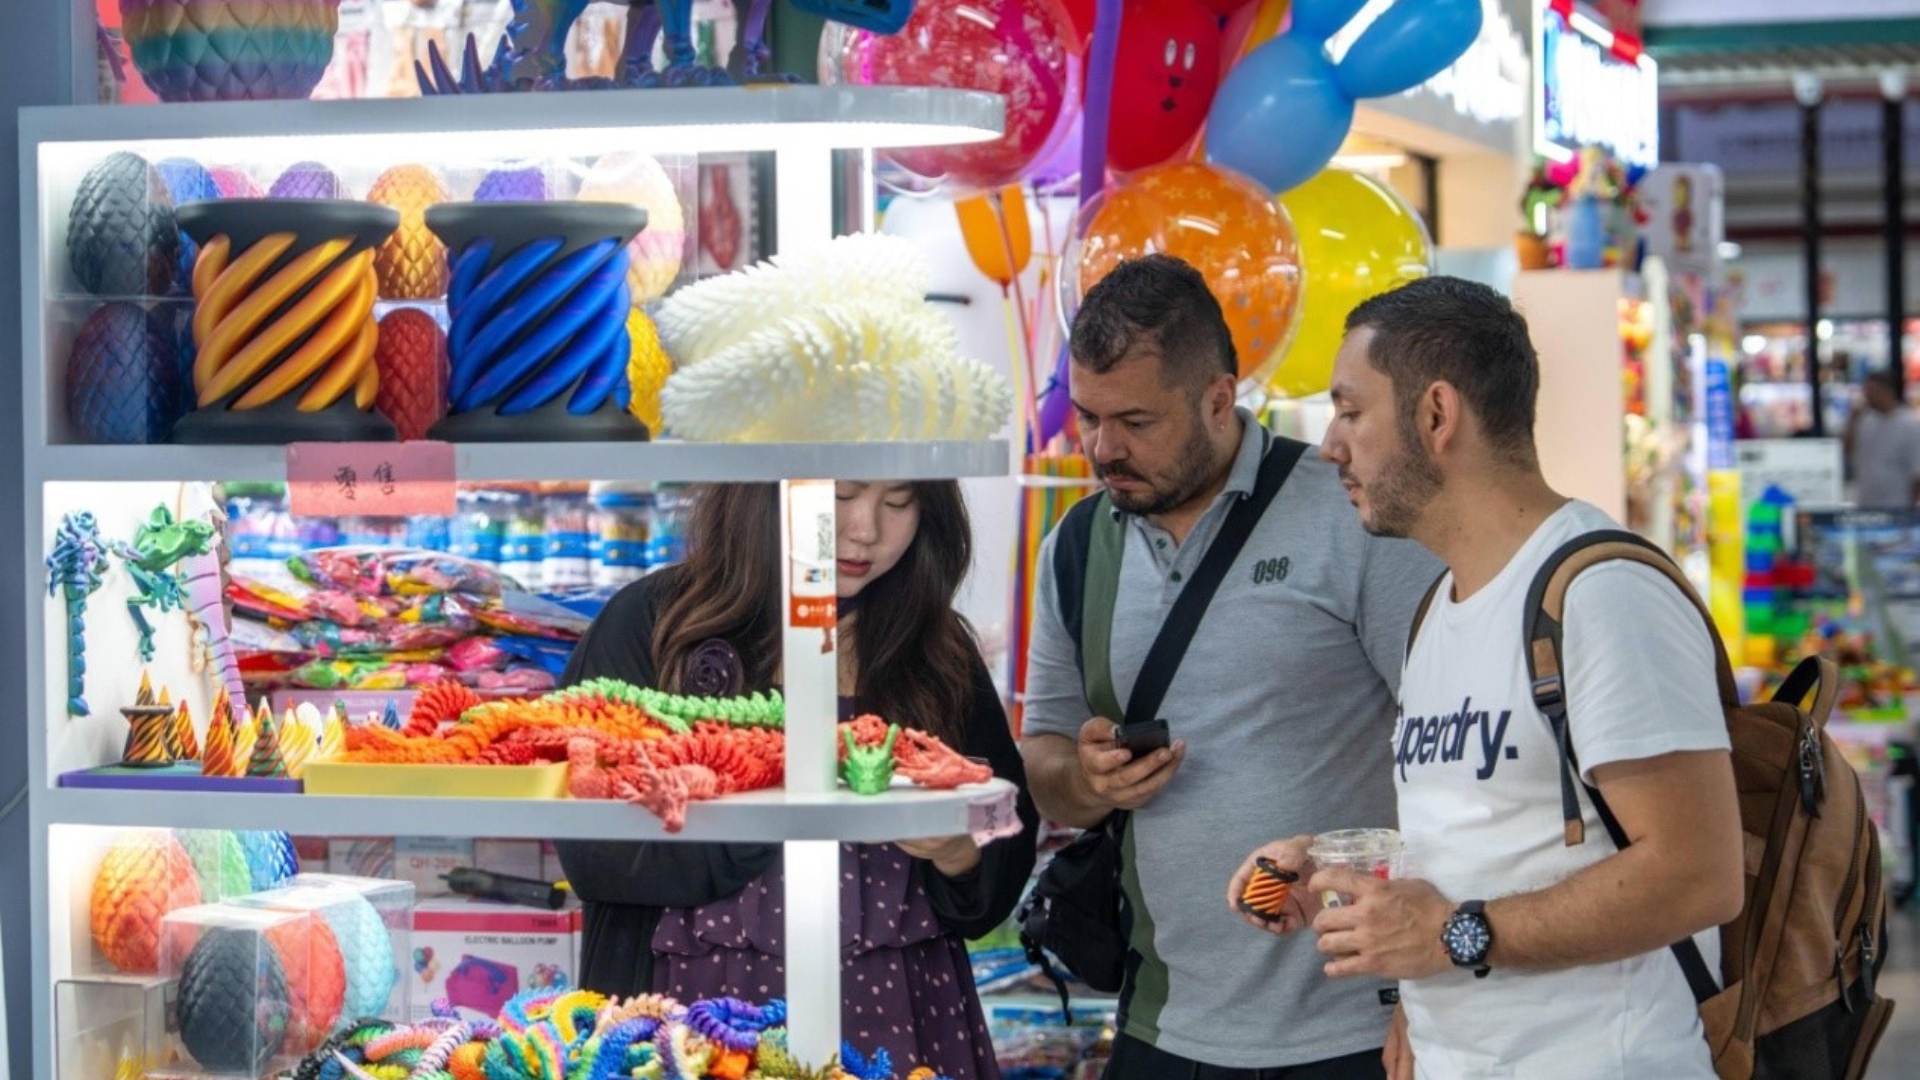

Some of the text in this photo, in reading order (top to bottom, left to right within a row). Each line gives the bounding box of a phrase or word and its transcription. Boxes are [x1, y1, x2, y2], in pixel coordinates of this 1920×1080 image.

[1252, 556, 1290, 585] 098
[1396, 695, 1519, 783] uperdry.
[465, 936, 557, 946] ELECTRIC BALLOON PUMP
